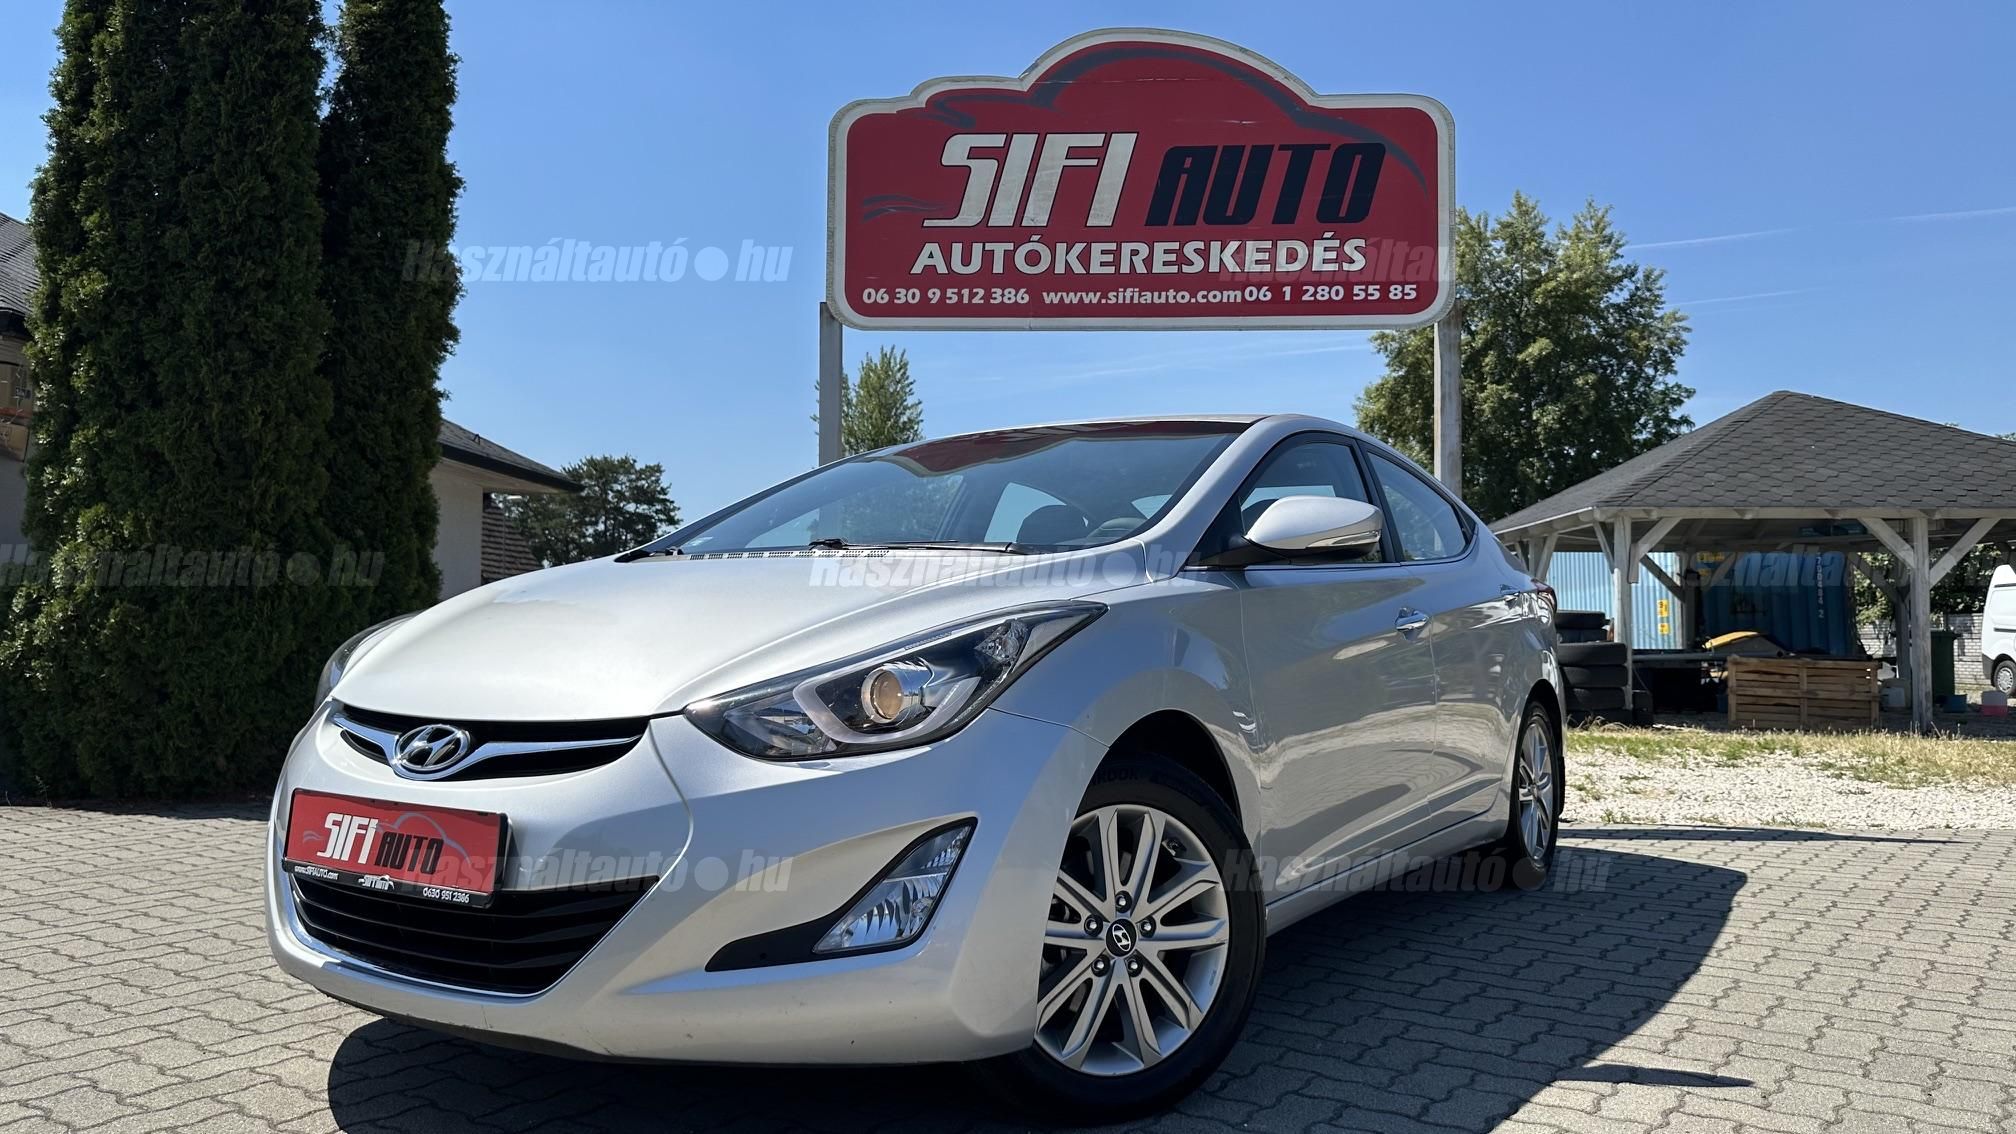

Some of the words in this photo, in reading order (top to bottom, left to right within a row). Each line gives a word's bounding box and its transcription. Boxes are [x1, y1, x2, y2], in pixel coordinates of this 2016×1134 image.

[921, 131, 1138, 228] SIFI
[1143, 142, 1387, 227] AUTO
[909, 231, 1368, 276] AUTÓKERESKEDÉS
[862, 288, 890, 304] 06
[893, 288, 921, 304] 30
[927, 288, 941, 304] 9
[945, 288, 985, 304] 512
[990, 288, 1030, 304] 386
[1042, 287, 1242, 305] www.sifiauto.com
[1244, 285, 1272, 301] 06
[1282, 285, 1292, 301] 1
[1302, 285, 1345, 301] 280
[1353, 284, 1381, 300] 55
[1389, 284, 1418, 300] 85
[374, 831, 445, 875] AUTO
